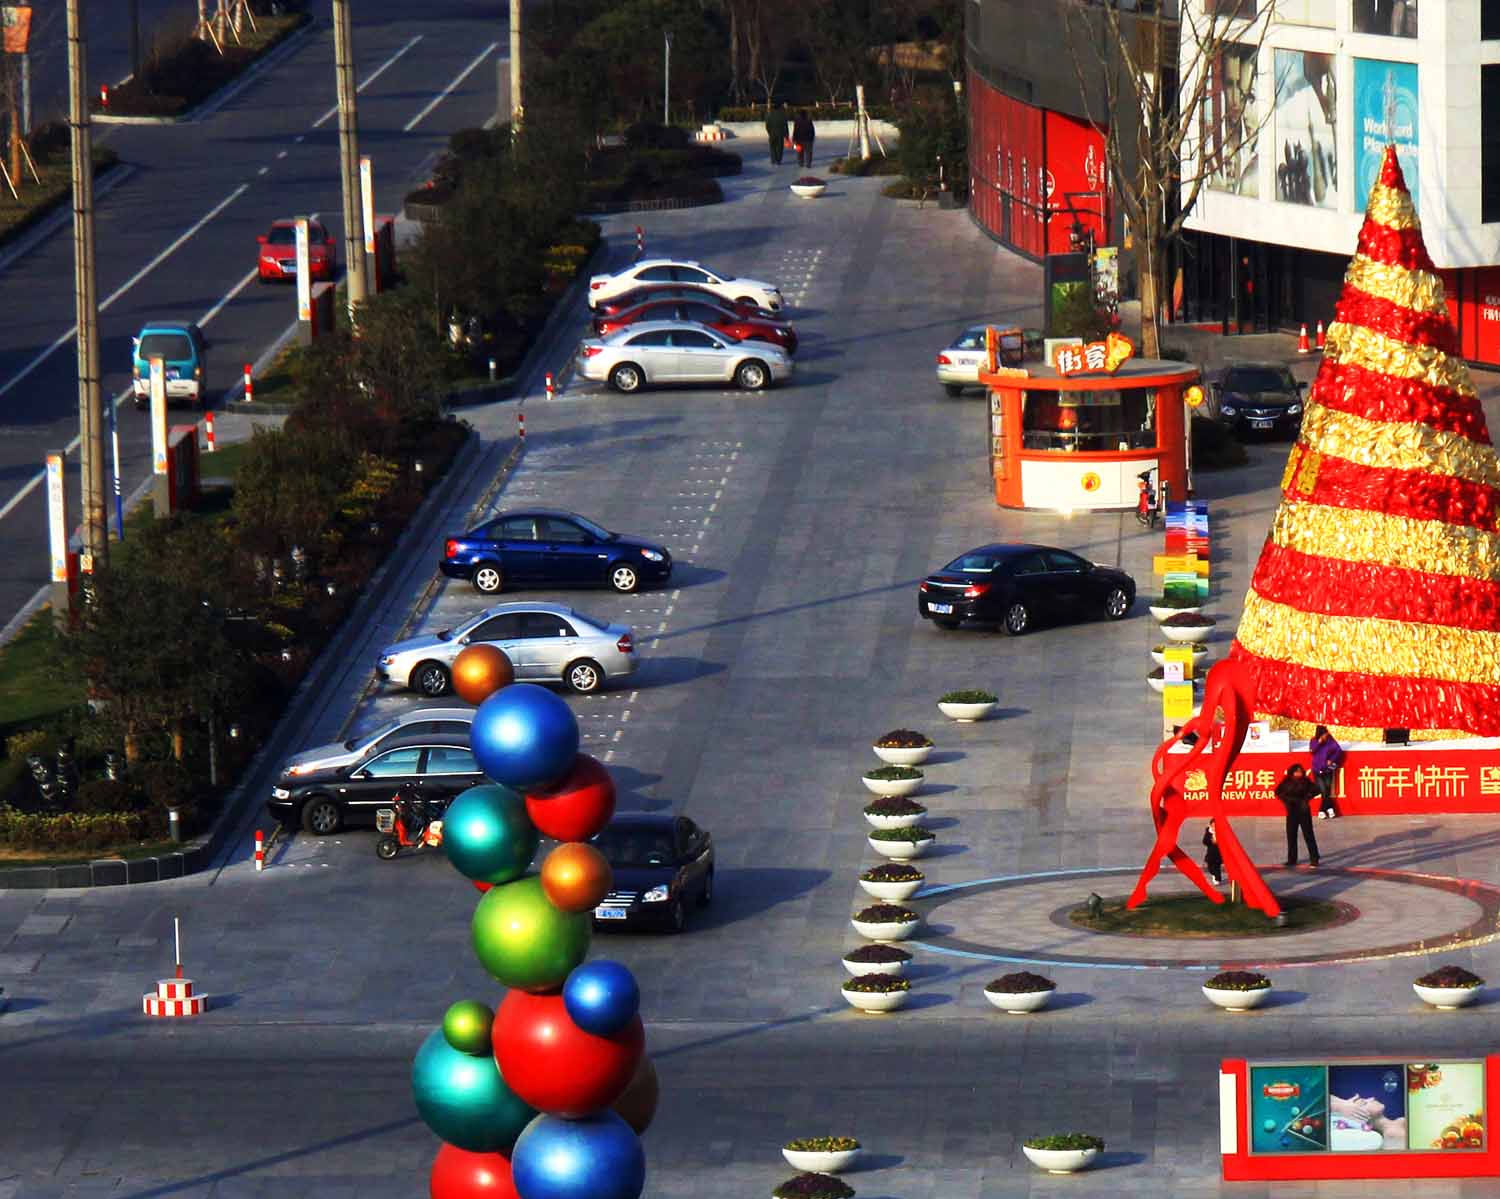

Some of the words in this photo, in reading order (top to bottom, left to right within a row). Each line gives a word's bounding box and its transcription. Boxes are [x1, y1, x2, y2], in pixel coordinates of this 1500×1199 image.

[1358, 764, 1470, 799] 新年快乐
[1221, 790, 1246, 801] NEW
[1249, 790, 1276, 801] YEAR
